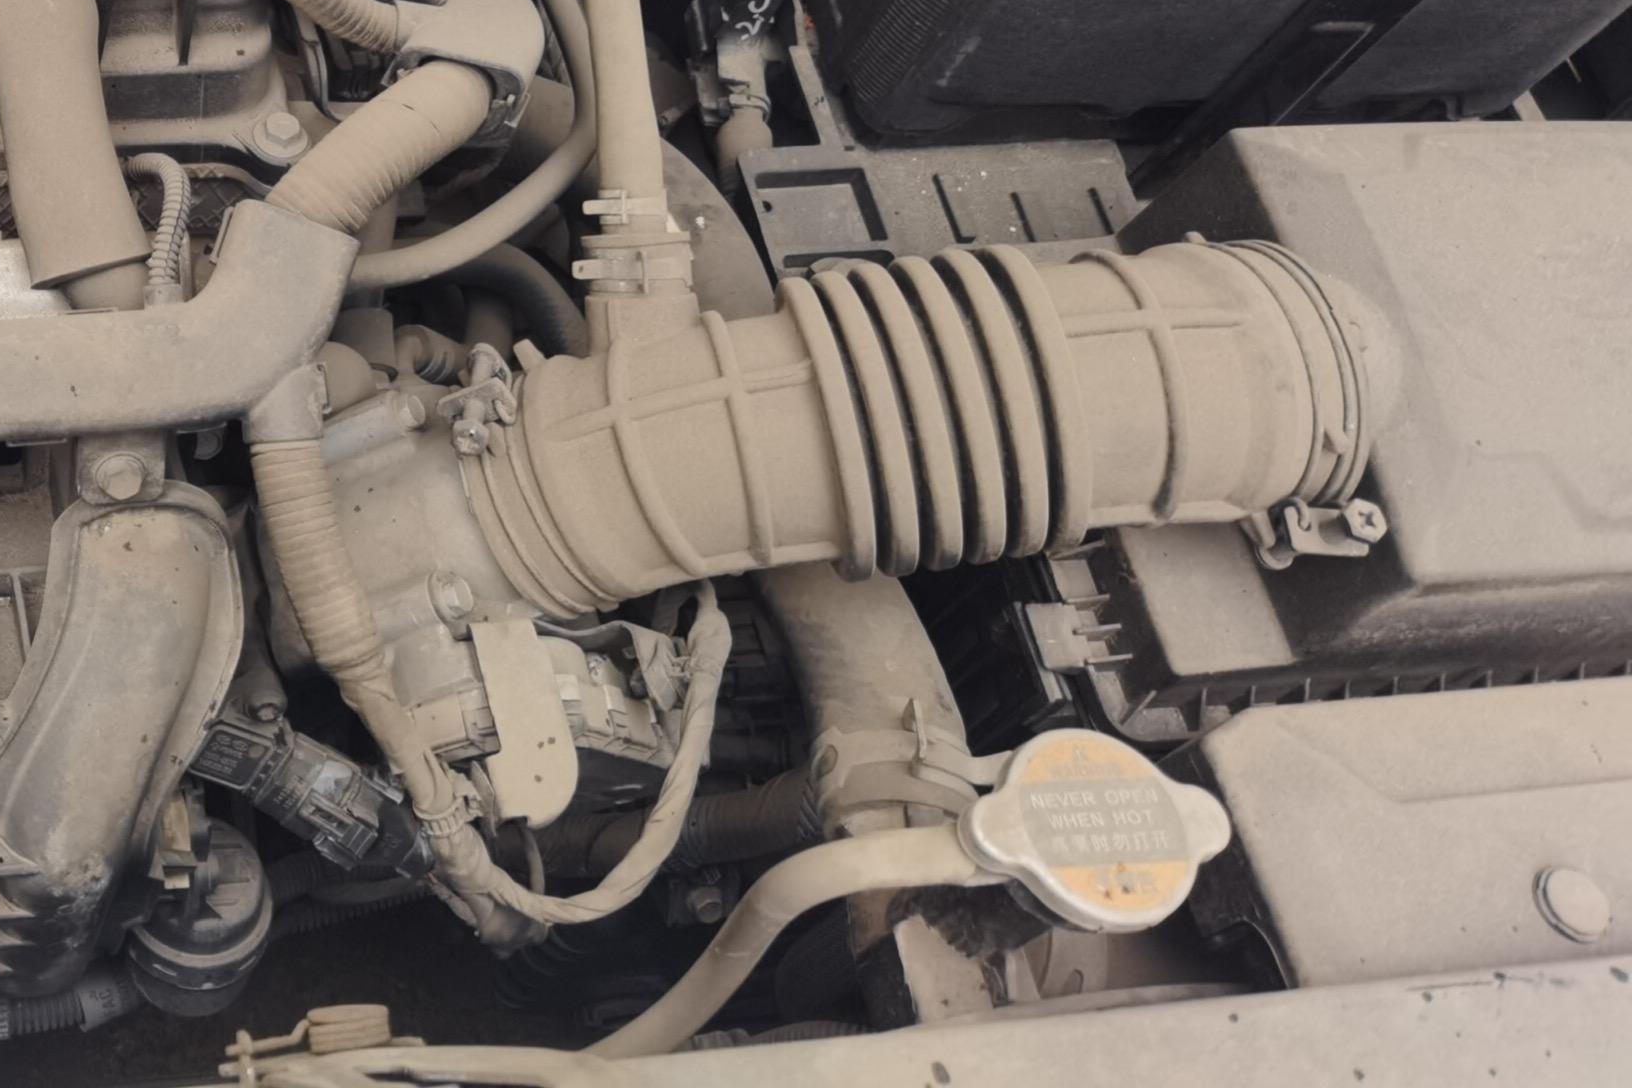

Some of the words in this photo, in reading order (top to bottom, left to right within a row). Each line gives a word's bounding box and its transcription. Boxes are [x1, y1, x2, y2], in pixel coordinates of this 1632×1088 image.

[1030, 790, 1097, 809] NEVER
[1103, 786, 1159, 806] OPEN
[1048, 811, 1105, 829] WHEN
[1111, 809, 1153, 825] HOT
